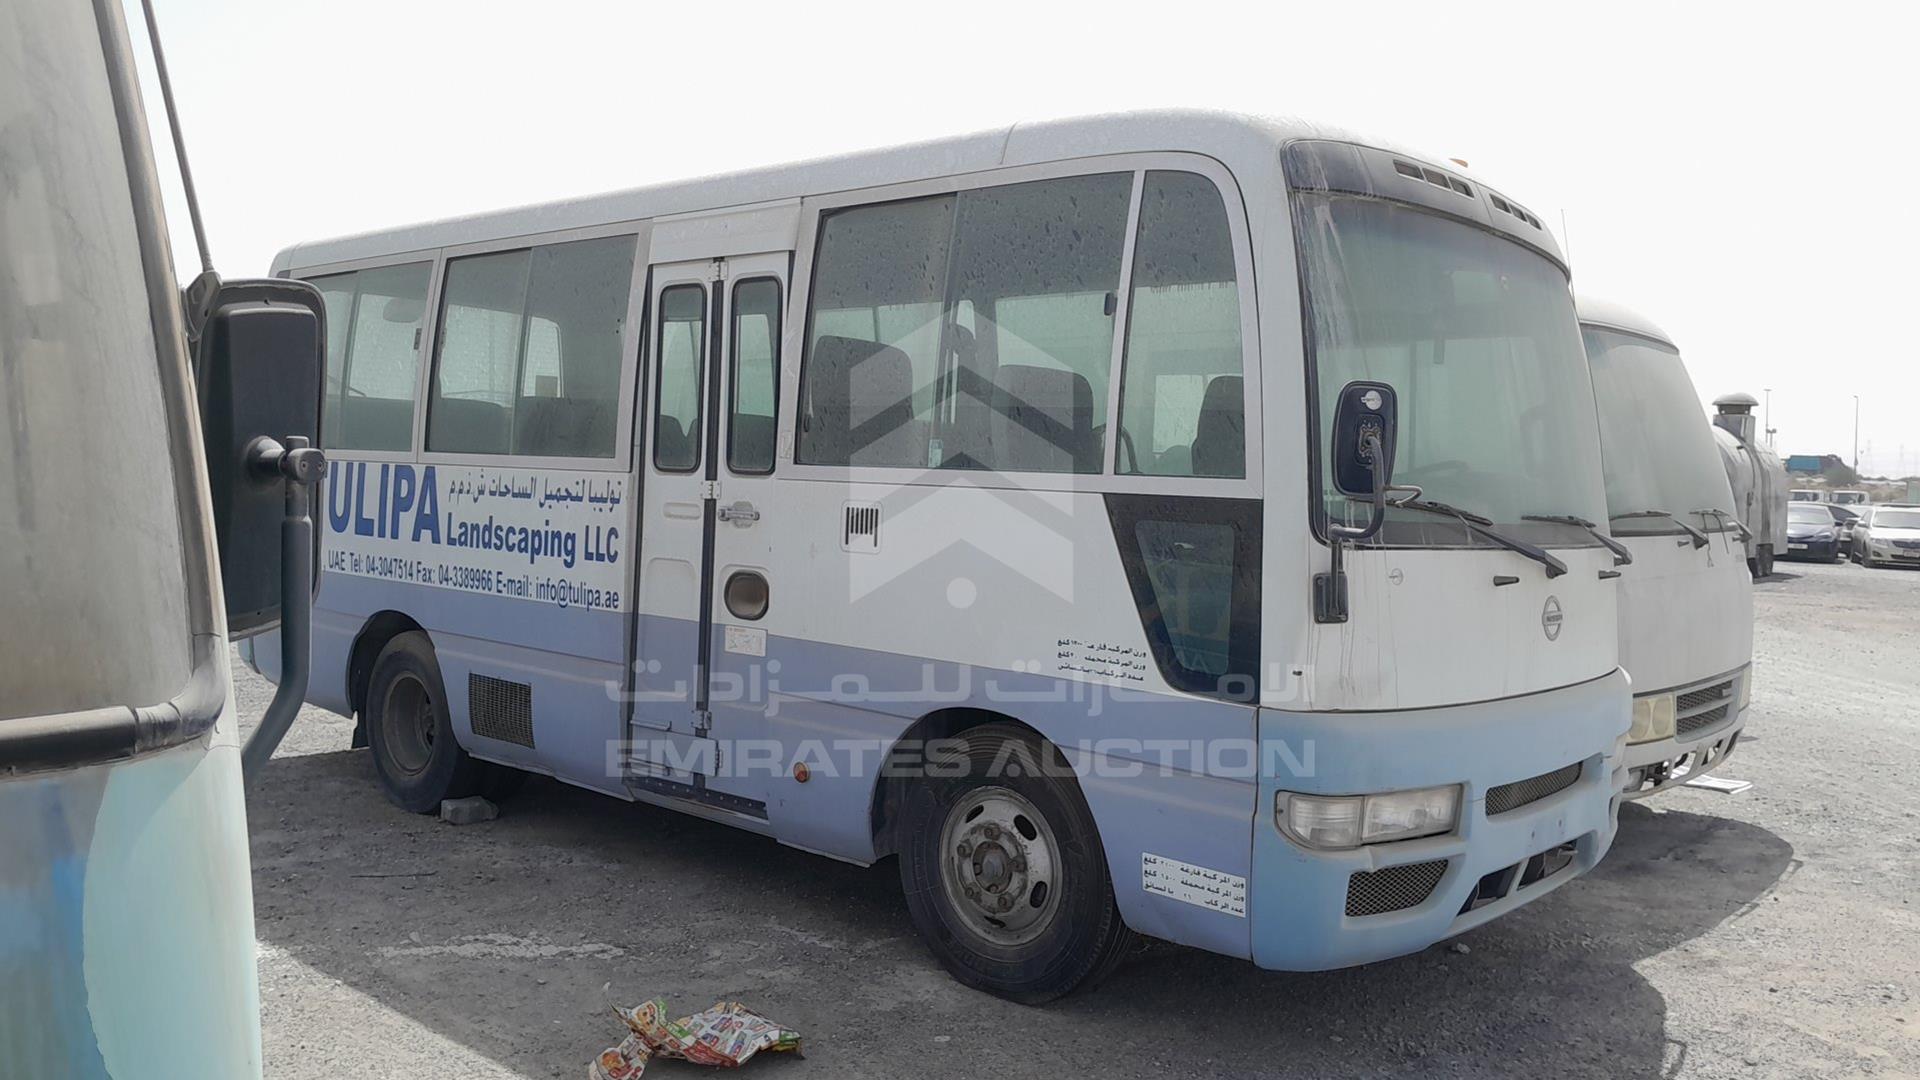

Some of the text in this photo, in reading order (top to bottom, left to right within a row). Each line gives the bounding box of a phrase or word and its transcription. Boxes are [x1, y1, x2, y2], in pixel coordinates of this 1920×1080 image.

[328, 461, 441, 545] ULIPA
[488, 473, 537, 499] الساحات
[539, 477, 586, 509] لتجميل
[588, 479, 622, 512] توليبا
[446, 512, 619, 568] Landscaping LLC
[328, 550, 619, 611] UAE Tel: 04-3047514 Fax: 04-3389966 E-mail: info@tulipa.ae
